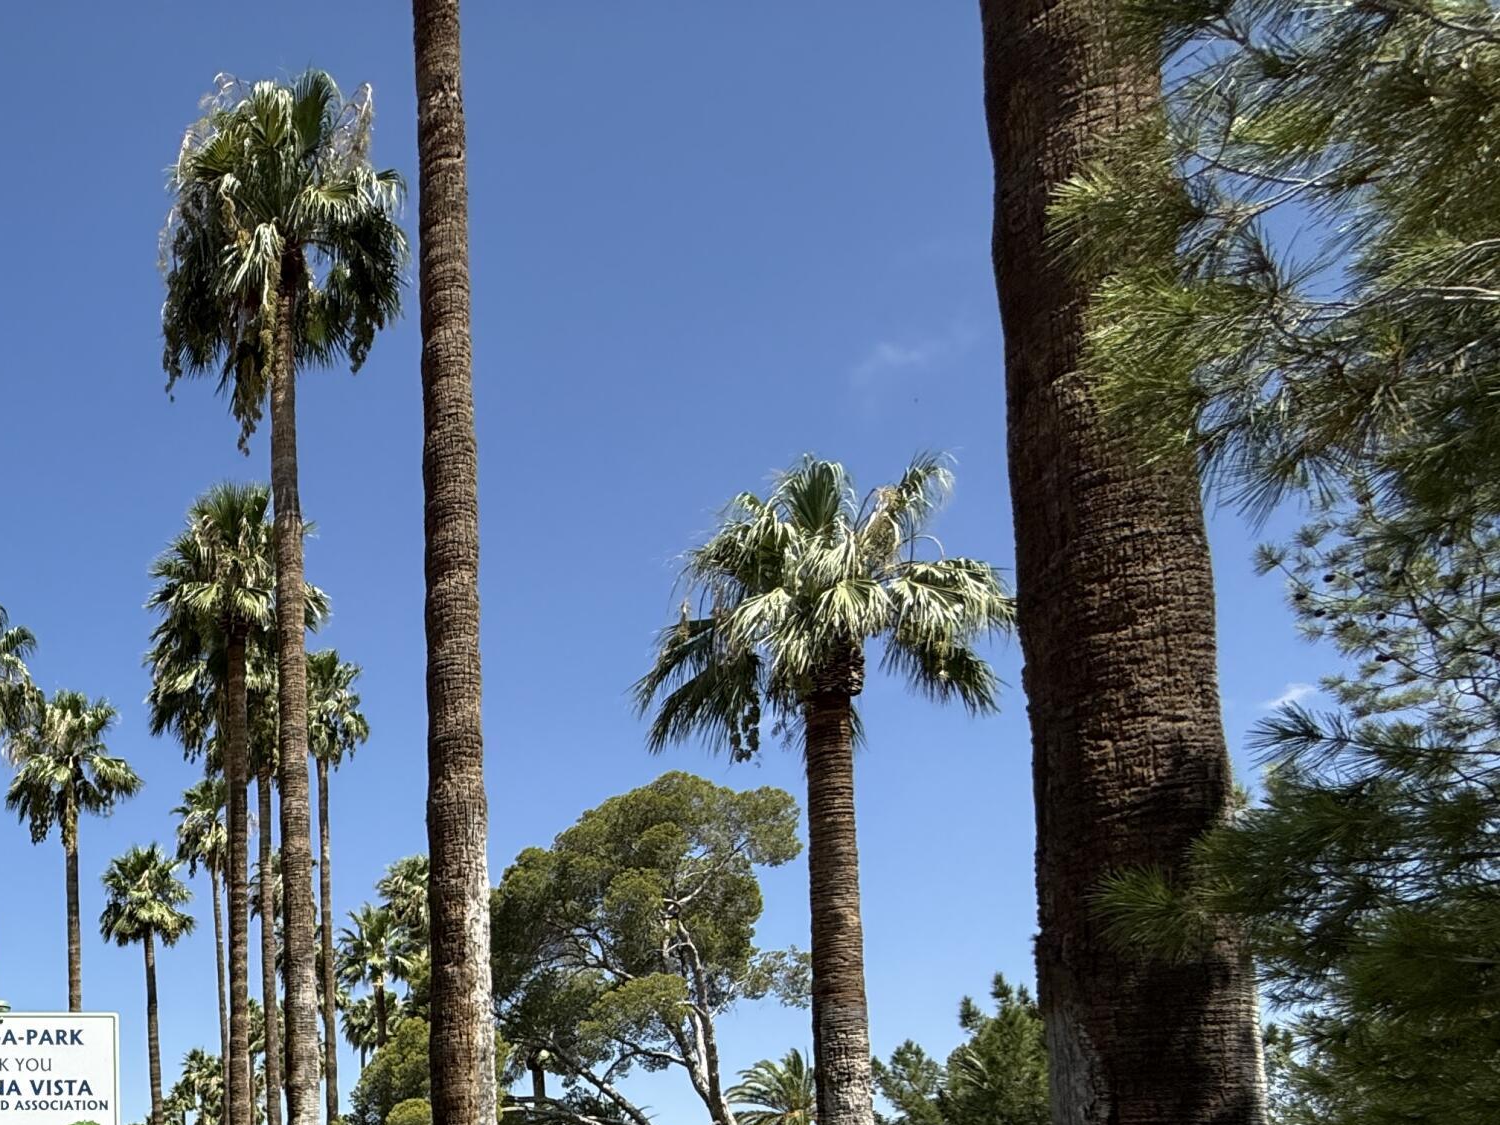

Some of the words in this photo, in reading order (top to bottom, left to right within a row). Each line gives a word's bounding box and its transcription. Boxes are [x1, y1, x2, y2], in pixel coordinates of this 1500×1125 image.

[14, 1058, 52, 1072] YOU
[30, 1079, 93, 1096] VISTA
[14, 1100, 109, 1111] ASSOCIATION
